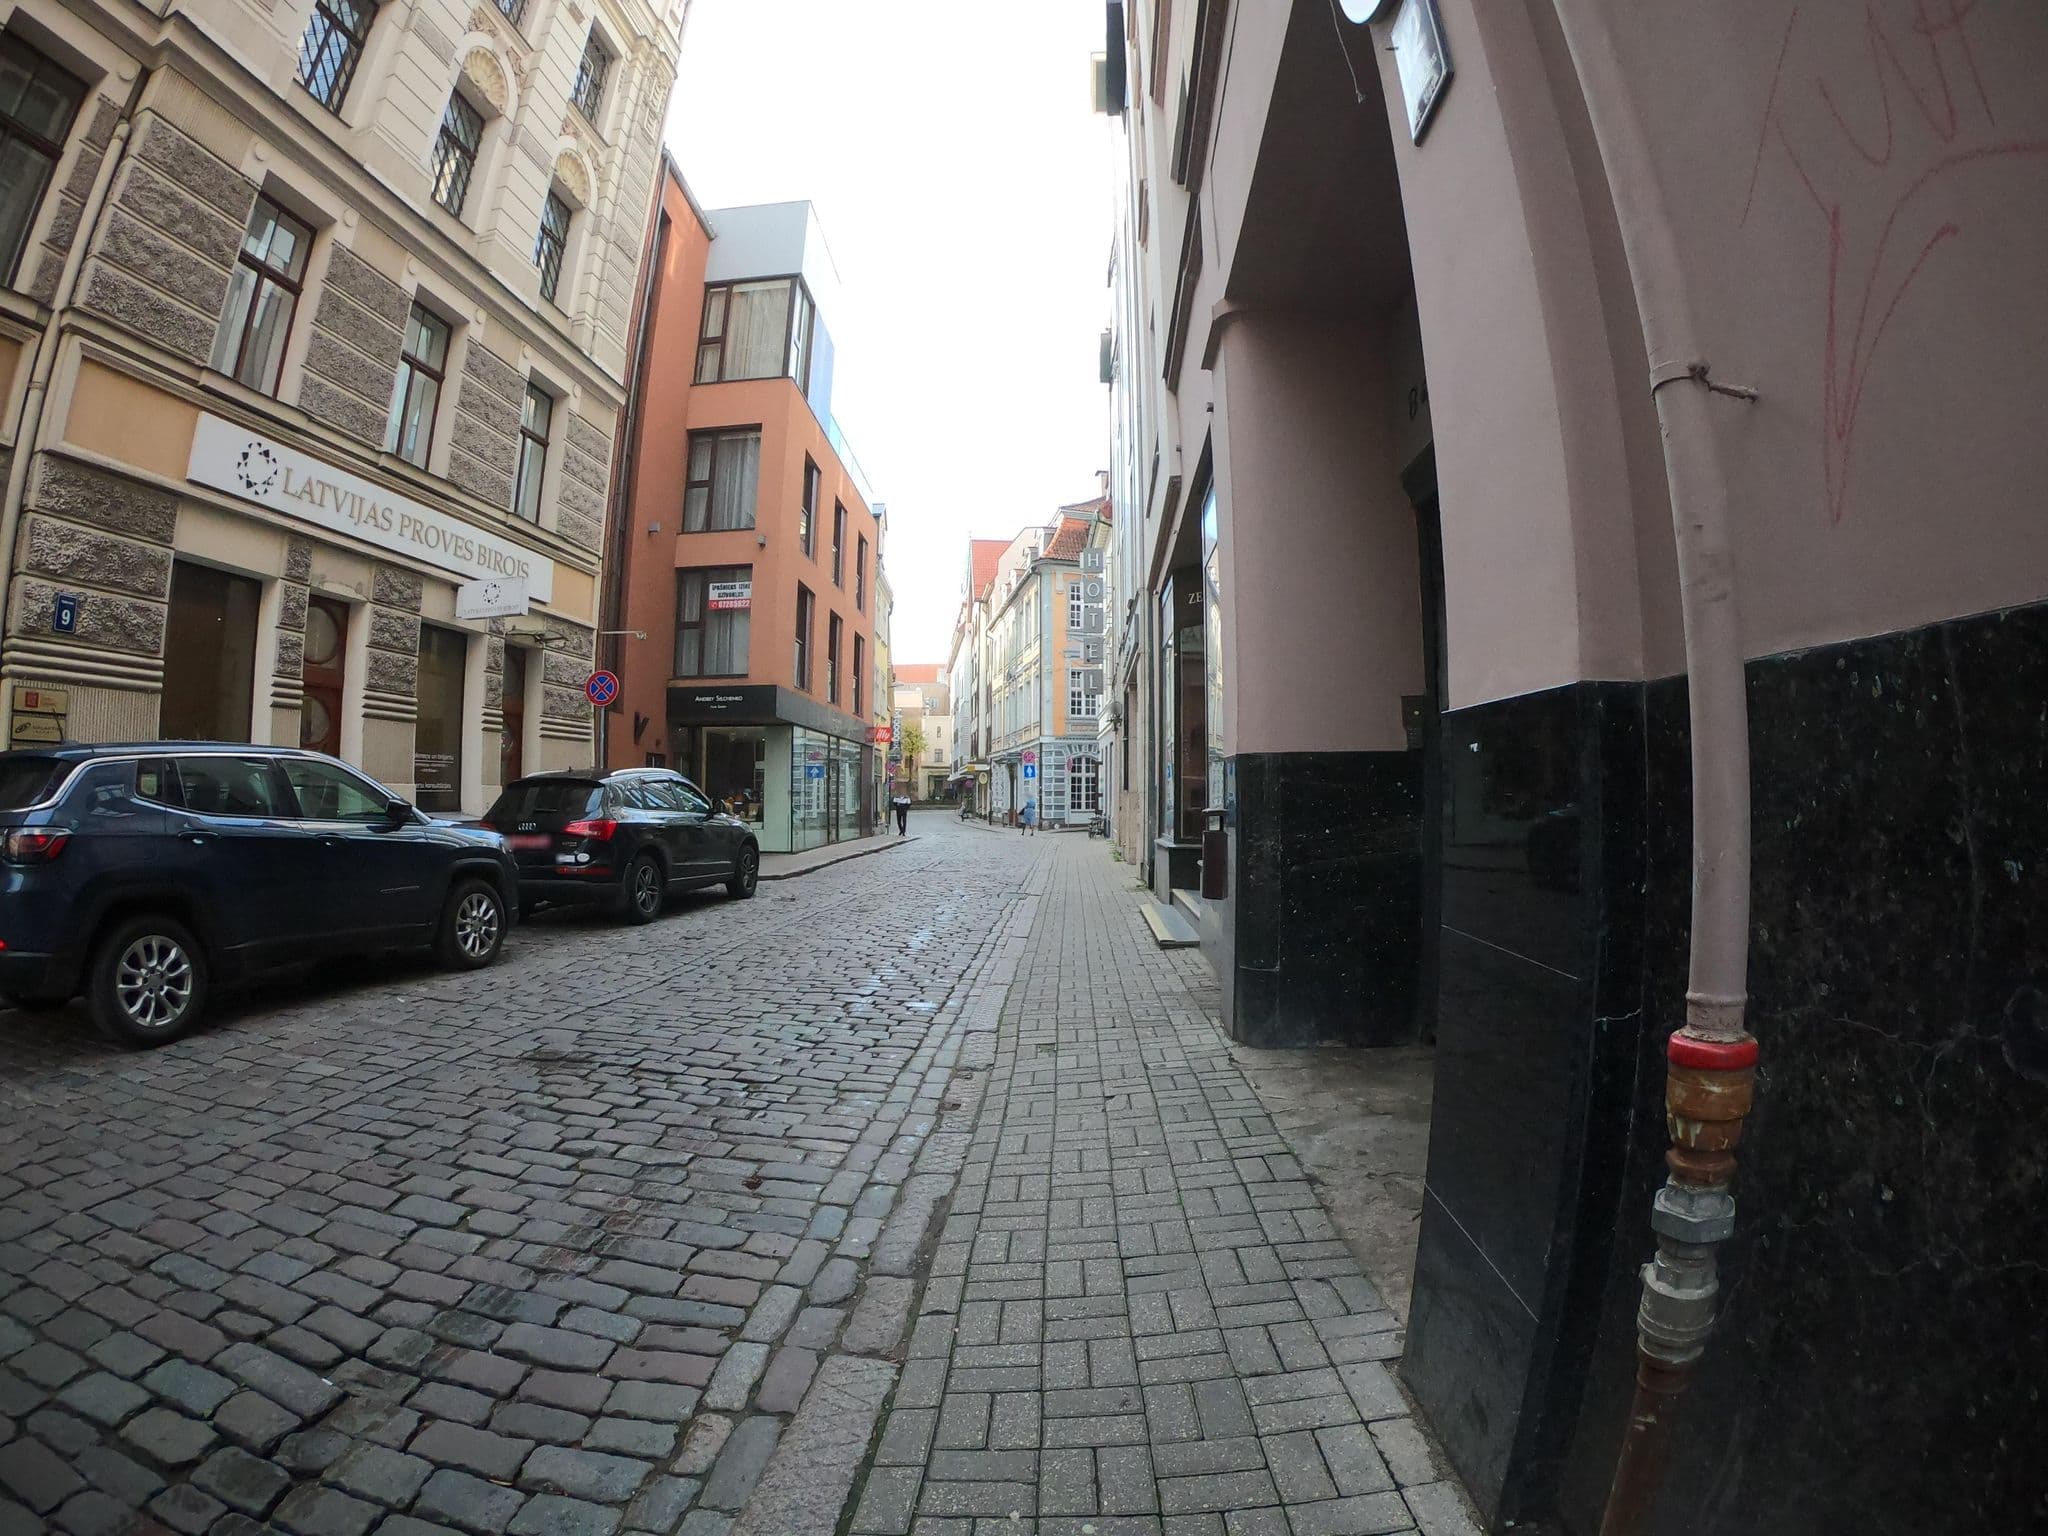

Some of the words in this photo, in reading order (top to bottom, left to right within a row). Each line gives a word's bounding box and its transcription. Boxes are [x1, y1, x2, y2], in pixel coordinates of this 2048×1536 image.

[282, 466, 393, 532] LATVIJAS
[398, 513, 474, 561] PROVES
[61, 609, 71, 625] 9
[1087, 552, 1100, 690] HOTEL
